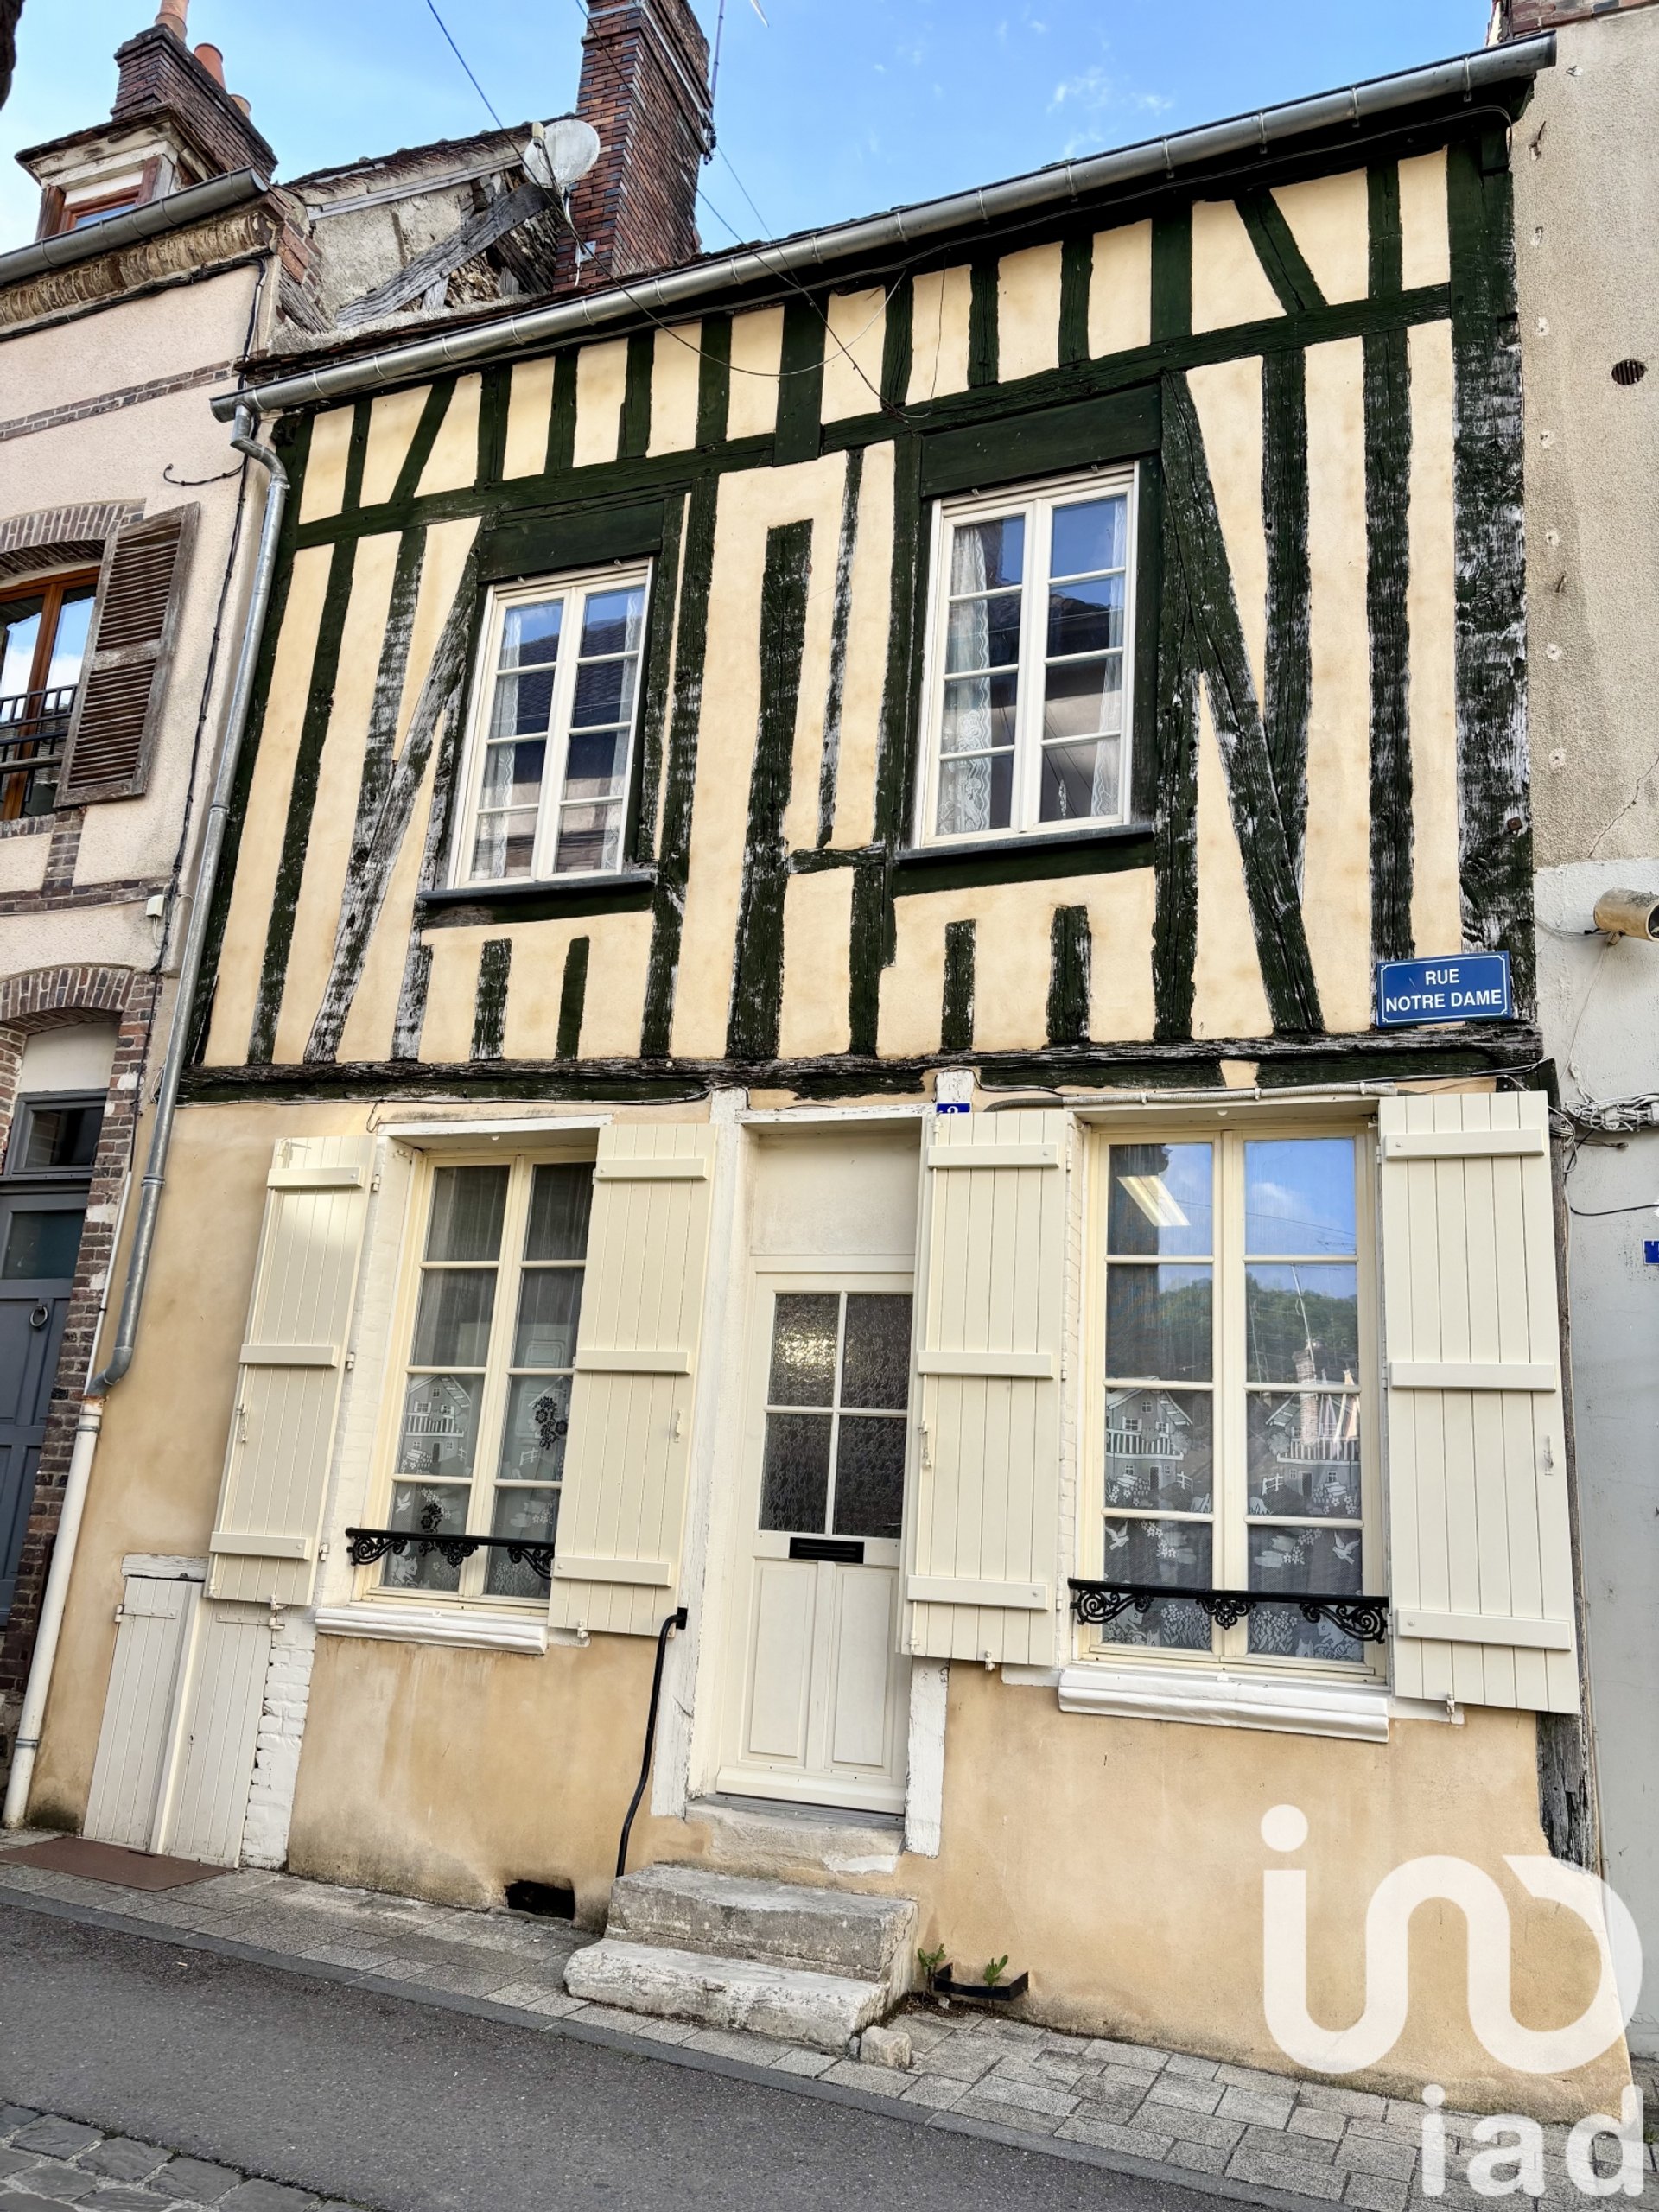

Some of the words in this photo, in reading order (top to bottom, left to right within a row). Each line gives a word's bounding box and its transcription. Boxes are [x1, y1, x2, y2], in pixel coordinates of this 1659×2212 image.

[1425, 969, 1460, 986] RUE
[1385, 993, 1446, 1013] NOTRE
[1451, 989, 1503, 1007] DAME
